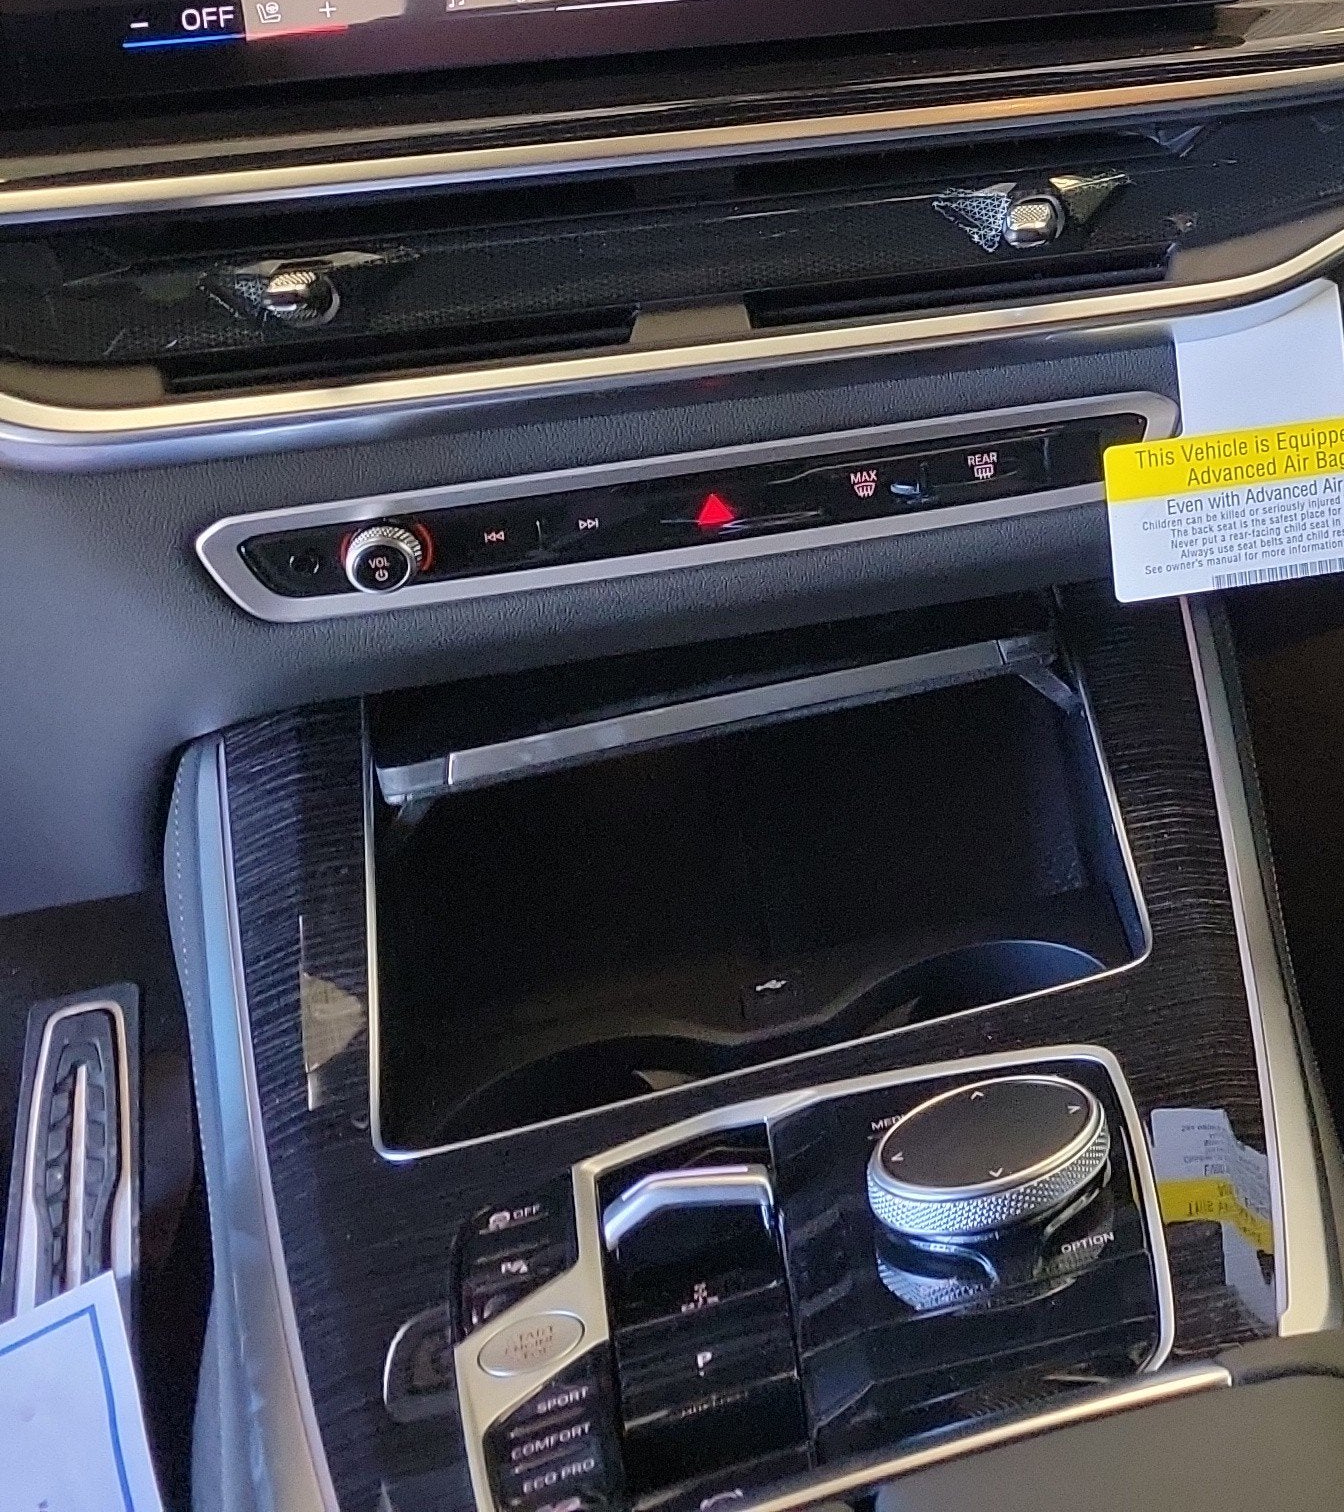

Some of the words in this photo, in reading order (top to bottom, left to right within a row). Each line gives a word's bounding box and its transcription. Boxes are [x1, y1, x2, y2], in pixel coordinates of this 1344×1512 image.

[181, 5, 235, 31] OFF
[967, 451, 998, 467] REAR
[1135, 449, 1175, 470] This
[1181, 438, 1249, 463] Vehicle
[1255, 434, 1270, 453] is
[850, 469, 878, 485] MAX
[1187, 457, 1277, 486] Advanced
[1284, 452, 1309, 473] Air
[1167, 497, 1204, 516] Even
[1208, 491, 1240, 510] with
[1245, 479, 1317, 505] Advanced
[1323, 476, 1343, 495] Air
[1142, 518, 1183, 532] Children
[1186, 516, 1203, 526] can
[1206, 512, 1218, 523] be
[1220, 508, 1246, 521] killed
[1249, 507, 1260, 517] or
[1262, 499, 1305, 515] seriously
[1308, 495, 1341, 509] injured
[1171, 527, 1189, 539] The
[1191, 523, 1215, 536] back
[1217, 521, 1237, 533] seat
[1240, 519, 1249, 530] is
[1251, 517, 1267, 528] the
[1270, 511, 1298, 525] safest
[1300, 509, 1325, 522] place
[1328, 506, 1342, 517] for
[1171, 536, 1200, 550] Never
[1202, 534, 1218, 548] put
[1220, 534, 1227, 543] a
[1229, 525, 1281, 542] rear-facing
[1284, 521, 1307, 535] child
[1309, 518, 1330, 530] seat
[1332, 516, 1342, 527] in
[1181, 545, 1215, 560] Always
[1217, 544, 1235, 555] use
[1237, 540, 1258, 552] seat
[1260, 536, 1284, 550] belts
[1286, 533, 1304, 544] and
[1306, 529, 1329, 543] child
[367, 556, 390, 569] VOL
[1145, 564, 1163, 575] See
[1166, 558, 1204, 573] owner's
[1206, 552, 1242, 567] manual
[1244, 550, 1259, 561] for
[1261, 547, 1286, 559] more
[1288, 539, 1343, 555] information
[871, 1114, 906, 1131] MED
[1061, 1231, 1115, 1254] OPTION
[697, 1351, 713, 1369] P
[537, 1385, 588, 1413] SPORT
[511, 1421, 591, 1461] COMFORT
[523, 1470, 557, 1493] ECO
[561, 1457, 595, 1479] PRO
